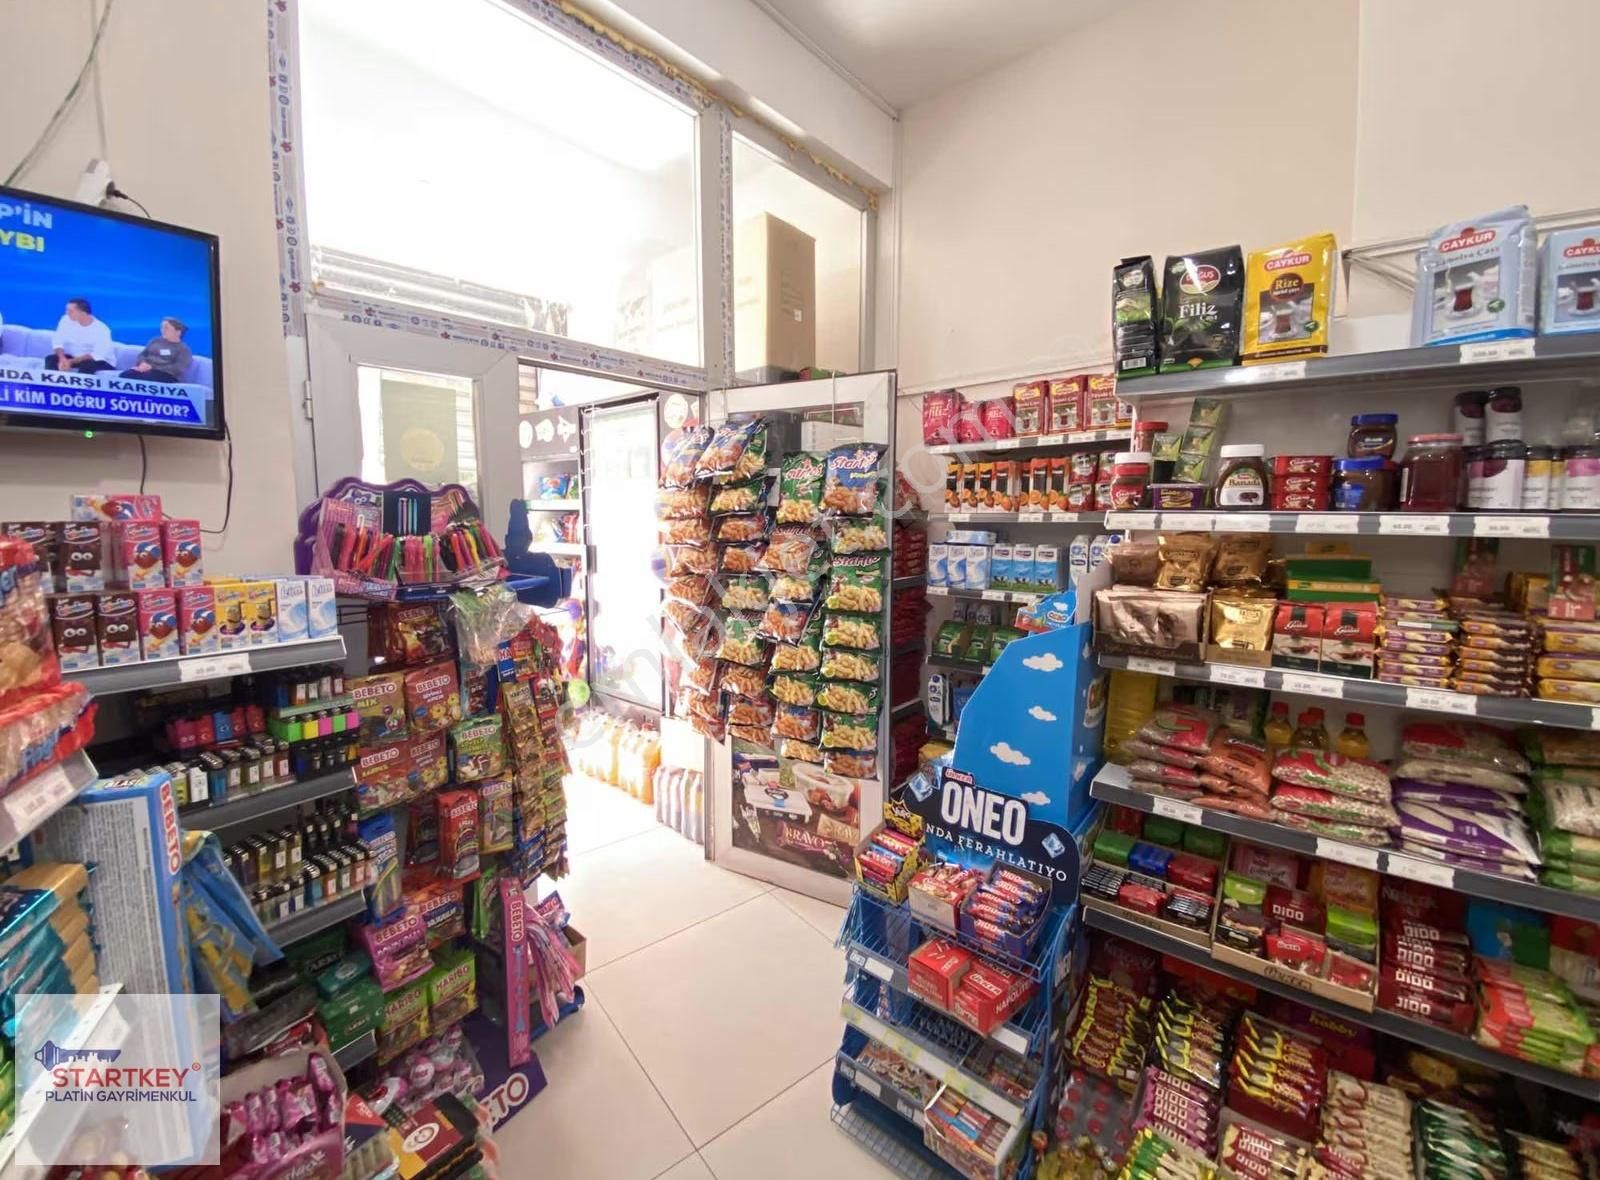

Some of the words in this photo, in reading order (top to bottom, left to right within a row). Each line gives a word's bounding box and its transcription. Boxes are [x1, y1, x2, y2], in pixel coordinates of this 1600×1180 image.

[1275, 278, 1299, 290] Rize
[1178, 302, 1218, 318] Filiz
[41, 374, 101, 388] KARŞI
[109, 381, 188, 397] KARŞIYA
[15, 387, 46, 404] KİM
[51, 390, 106, 410] DOĞRU
[110, 396, 190, 417] SÖYLÜYOR?
[353, 683, 397, 699] BEBETO
[361, 748, 400, 768] BEBETO
[941, 781, 1027, 846] ONEO
[161, 781, 182, 875] BEBETO
[926, 823, 954, 842] NDA
[958, 835, 1068, 882] FERAHLATIYO
[511, 901, 524, 941] BEBETO
[1272, 904, 1304, 921] DIDO
[375, 917, 418, 944] BEBETO
